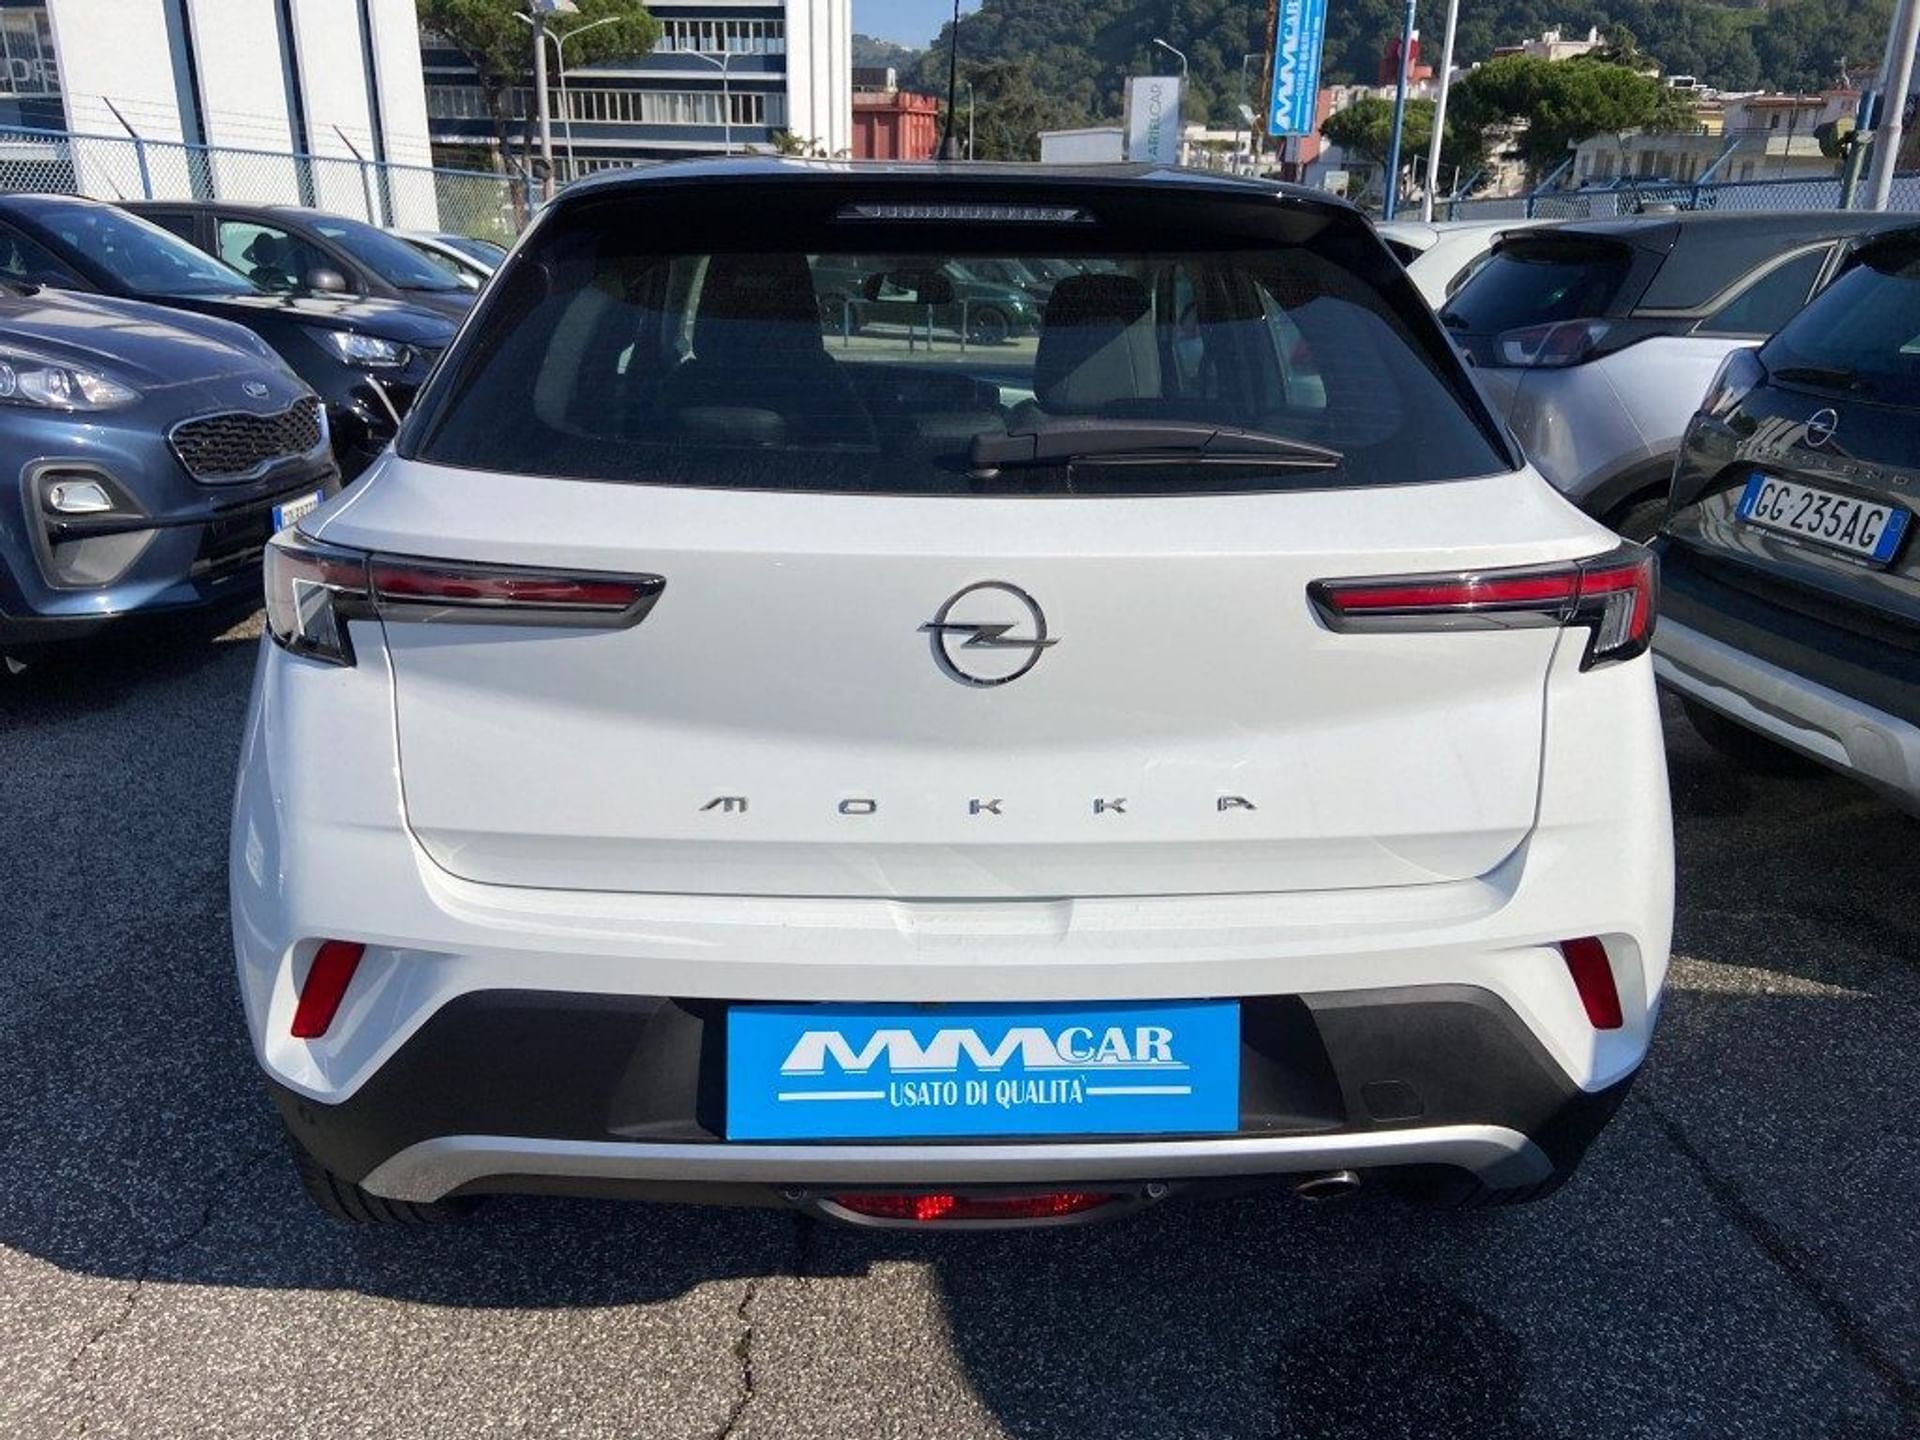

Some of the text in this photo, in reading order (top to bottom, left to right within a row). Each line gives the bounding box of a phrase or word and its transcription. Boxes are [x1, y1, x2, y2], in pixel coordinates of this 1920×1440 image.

[1755, 483, 1790, 522] GG
[1790, 491, 1884, 549] 235AG
[890, 1080, 958, 1107] USATO
[965, 1079, 988, 1106] DI
